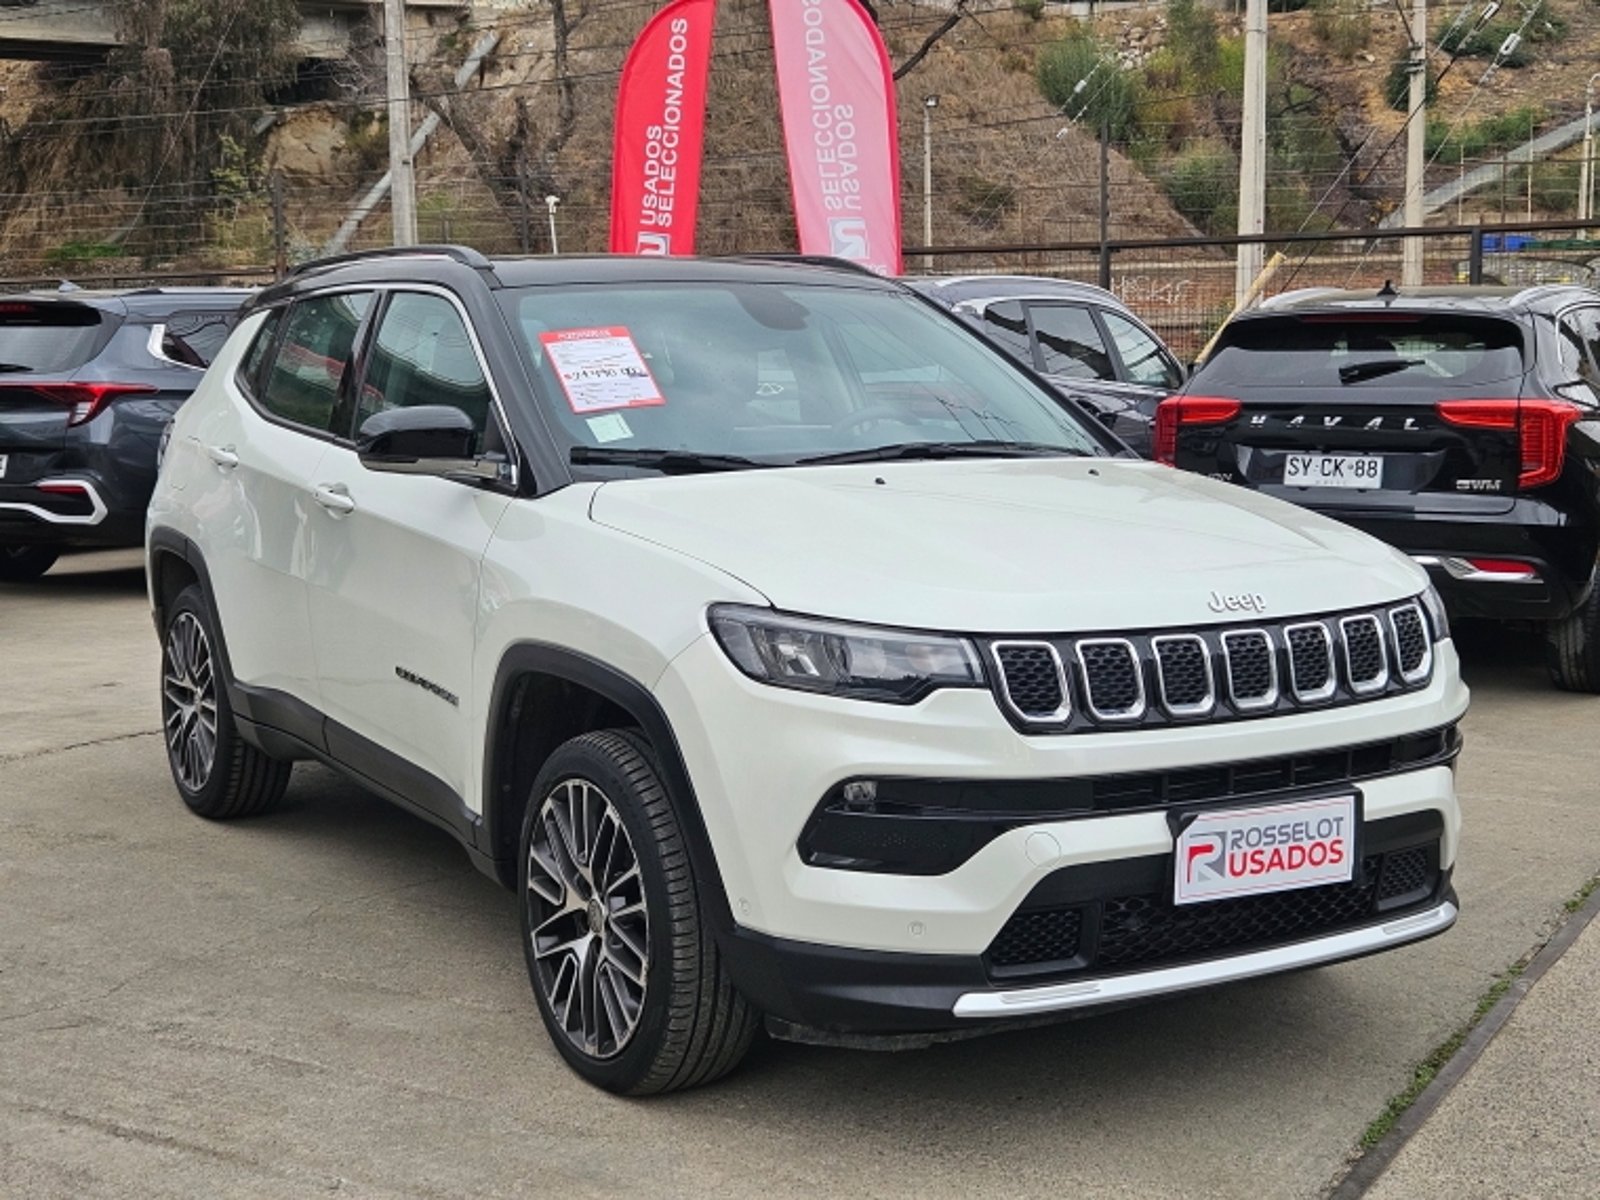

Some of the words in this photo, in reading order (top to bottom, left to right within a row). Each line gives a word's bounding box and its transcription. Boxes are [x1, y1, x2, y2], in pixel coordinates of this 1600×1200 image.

[655, 18, 688, 228] SELECCIONADOS
[640, 125, 662, 225] USADOS
[1249, 414, 1420, 431] HAVAL
[1287, 456, 1313, 477] SY
[1321, 457, 1346, 478] CK
[1354, 459, 1378, 479] 88
[1208, 590, 1266, 613] Jeep
[1231, 816, 1344, 850] ROSSELOT
[1229, 839, 1344, 877] USADOS
